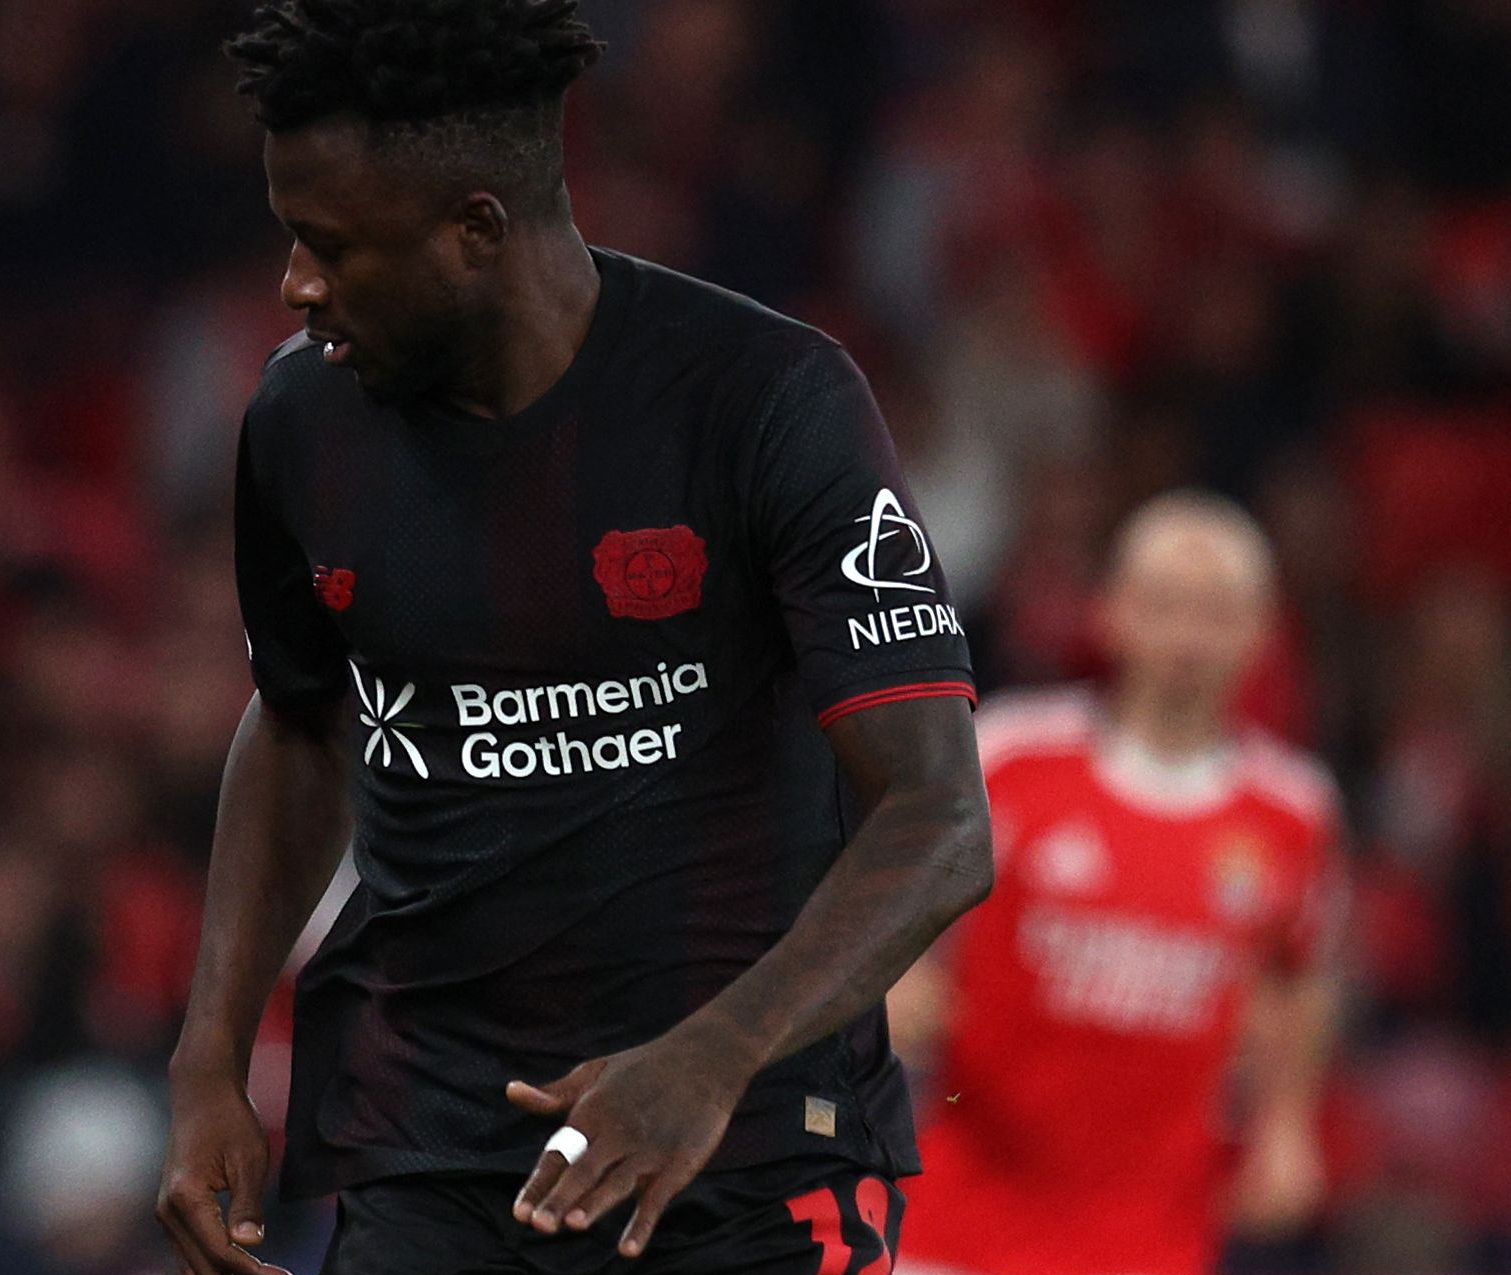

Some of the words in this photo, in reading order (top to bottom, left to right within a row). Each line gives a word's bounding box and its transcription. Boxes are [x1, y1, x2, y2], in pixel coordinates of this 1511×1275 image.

[847, 603, 966, 650] NIEDAX
[451, 661, 709, 727] Barmenia
[461, 723, 682, 778] Gothaer
